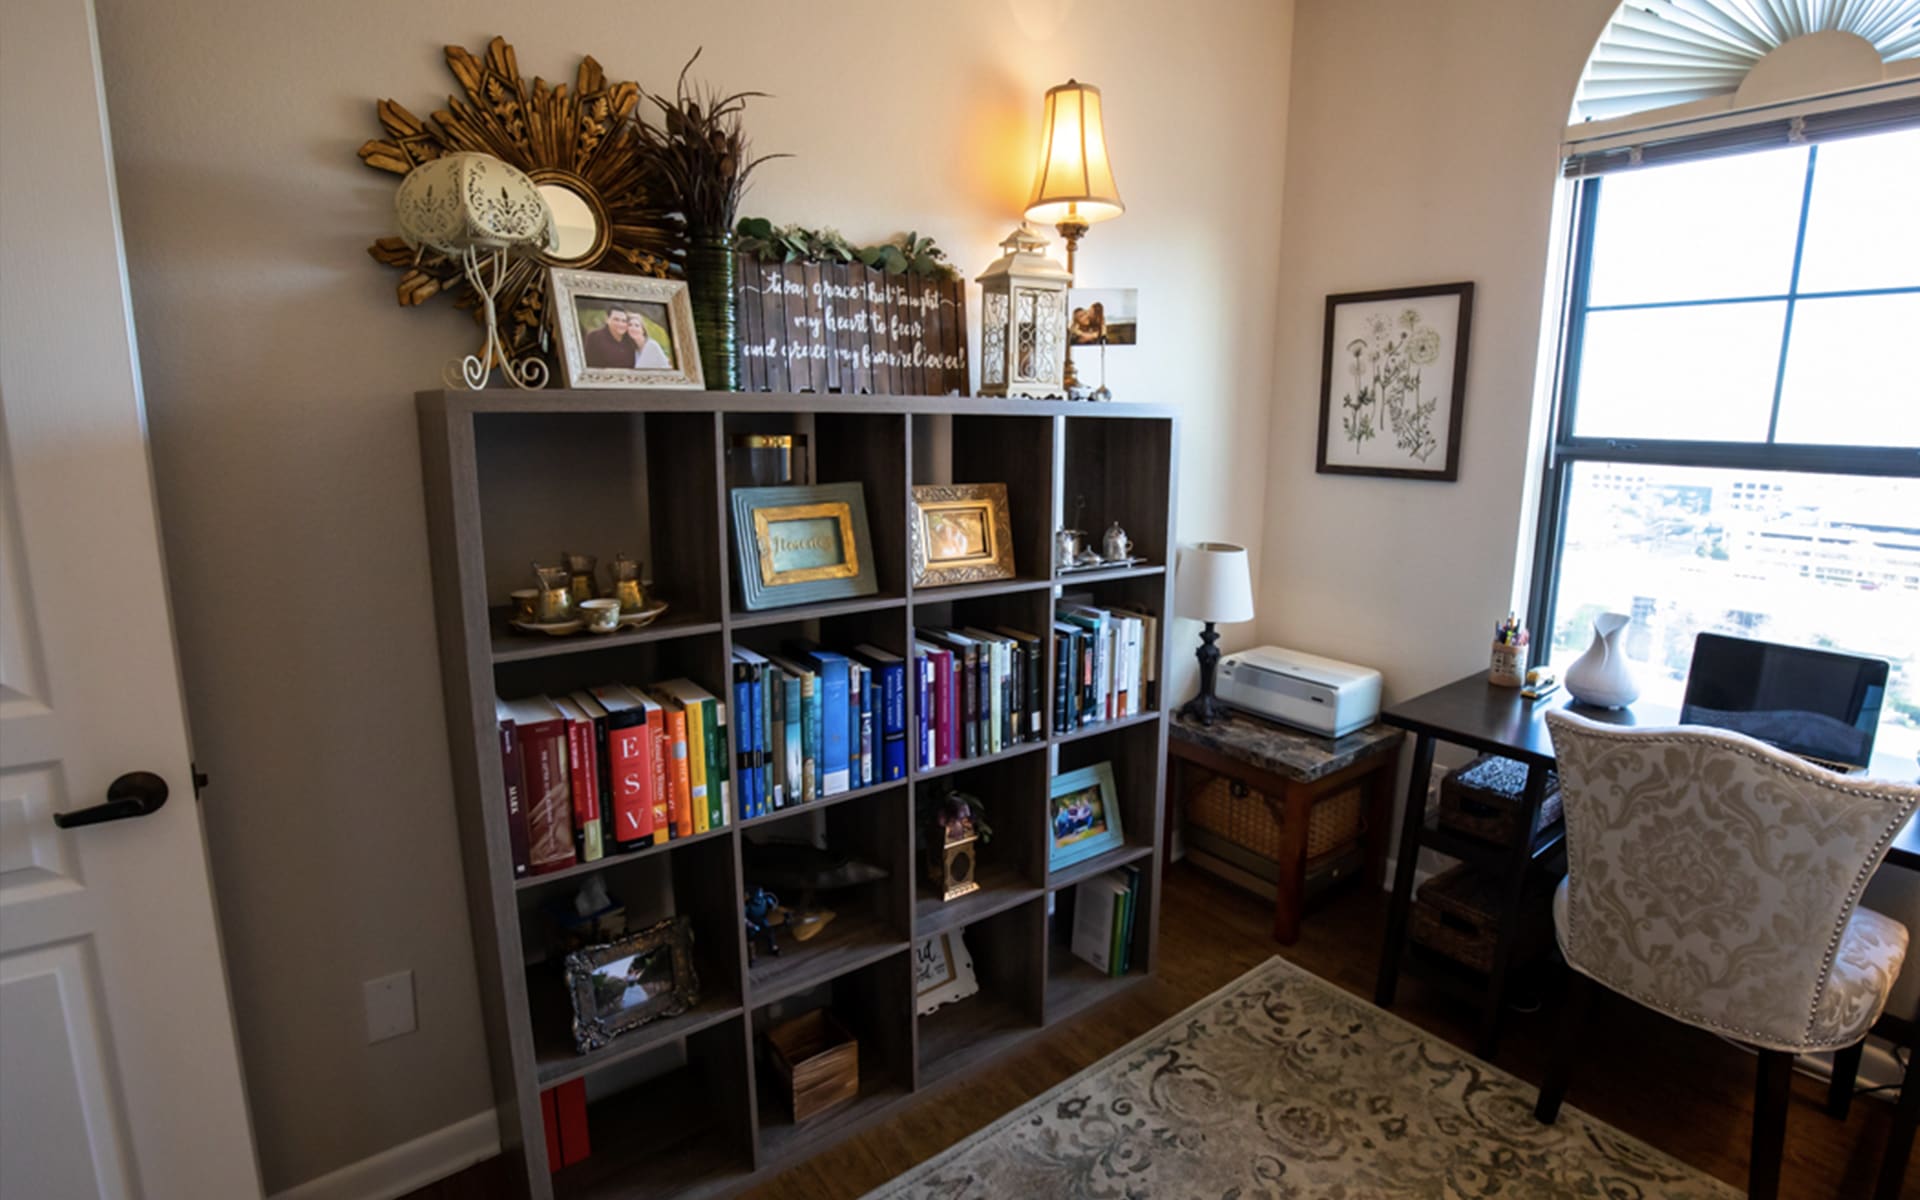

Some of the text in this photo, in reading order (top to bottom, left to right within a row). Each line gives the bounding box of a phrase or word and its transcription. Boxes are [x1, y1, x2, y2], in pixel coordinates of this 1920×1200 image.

[812, 281, 859, 309] grace
[860, 282, 895, 304] that
[893, 285, 941, 317] taught
[794, 316, 821, 338] my
[825, 305, 869, 333] heart
[870, 311, 886, 334] to
[743, 338, 778, 358] and
[781, 341, 829, 368] grace
[834, 348, 860, 369] my
[861, 344, 896, 368] fears
[622, 736, 644, 830] ESV
